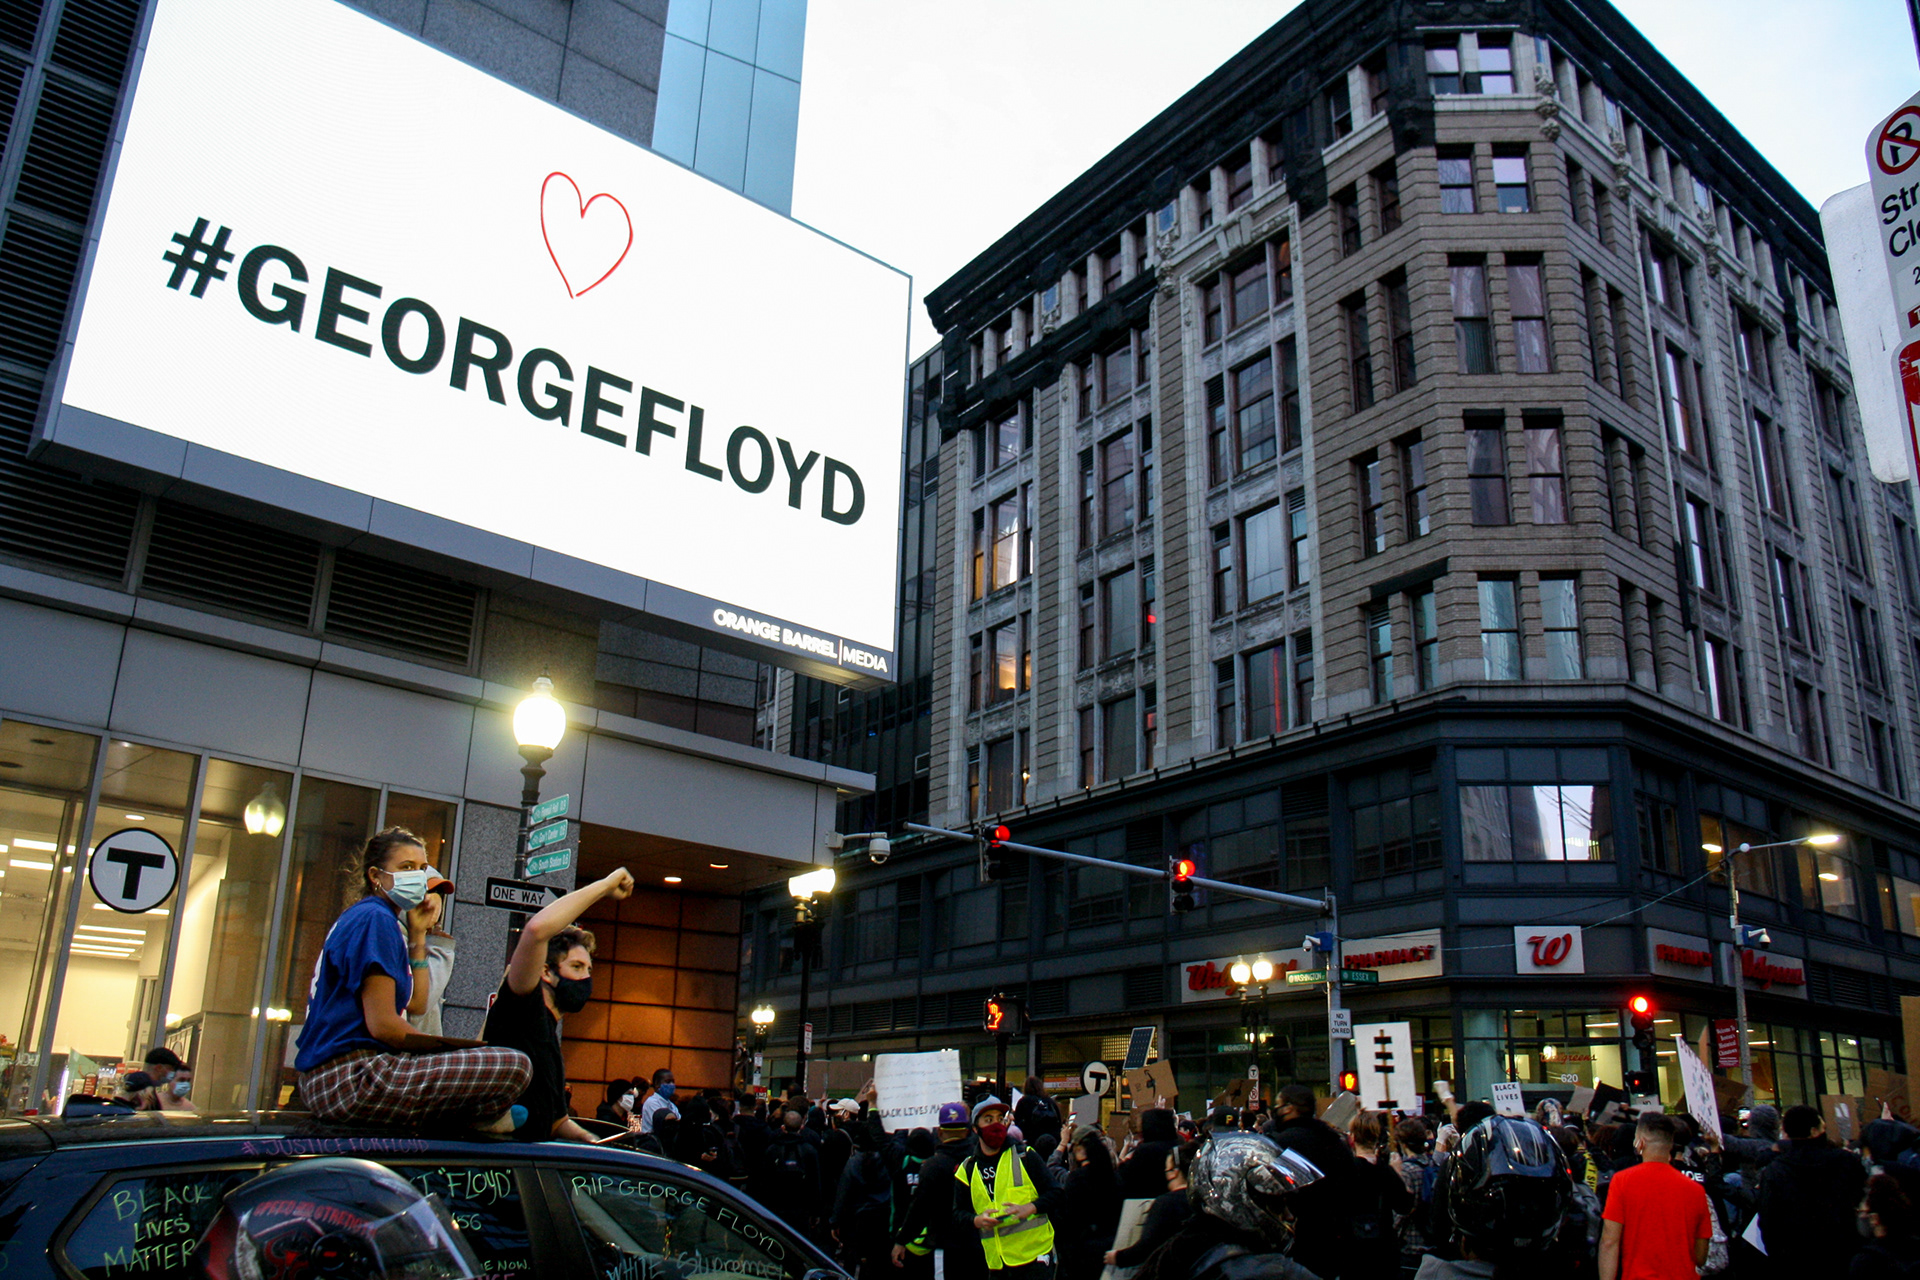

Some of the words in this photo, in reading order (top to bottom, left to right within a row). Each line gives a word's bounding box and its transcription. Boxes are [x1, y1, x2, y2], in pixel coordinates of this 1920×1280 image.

[1888, 219, 1920, 258] Cl
[162, 216, 866, 526] #GEORGEFLOYD
[713, 608, 781, 642] ORANGE
[782, 628, 838, 659] BARREL
[842, 646, 888, 673] MEDIA
[107, 847, 166, 901] T
[493, 886, 516, 901] ONE
[521, 890, 545, 905] WAY
[1344, 944, 1435, 970] PHARMACY
[1527, 933, 1572, 966] W
[1351, 971, 1369, 981] ESSEX
[1340, 1026, 1351, 1034] RED
[1540, 1051, 1597, 1065] Walgreens
[1089, 1071, 1107, 1092] T
[1494, 1083, 1516, 1091] BLACK
[1561, 1073, 1579, 1083] 620
[904, 1105, 928, 1116] LIVES
[1225, 1114, 1234, 1124] P
[113, 1184, 213, 1221] BLACK
[133, 1212, 190, 1244] LIVES
[571, 1175, 614, 1197] RIP
[618, 1179, 711, 1214] GEORGE
[716, 1207, 785, 1261] FLOYD
[103, 1238, 197, 1279] MATTER
[606, 1254, 666, 1280] WHITE
